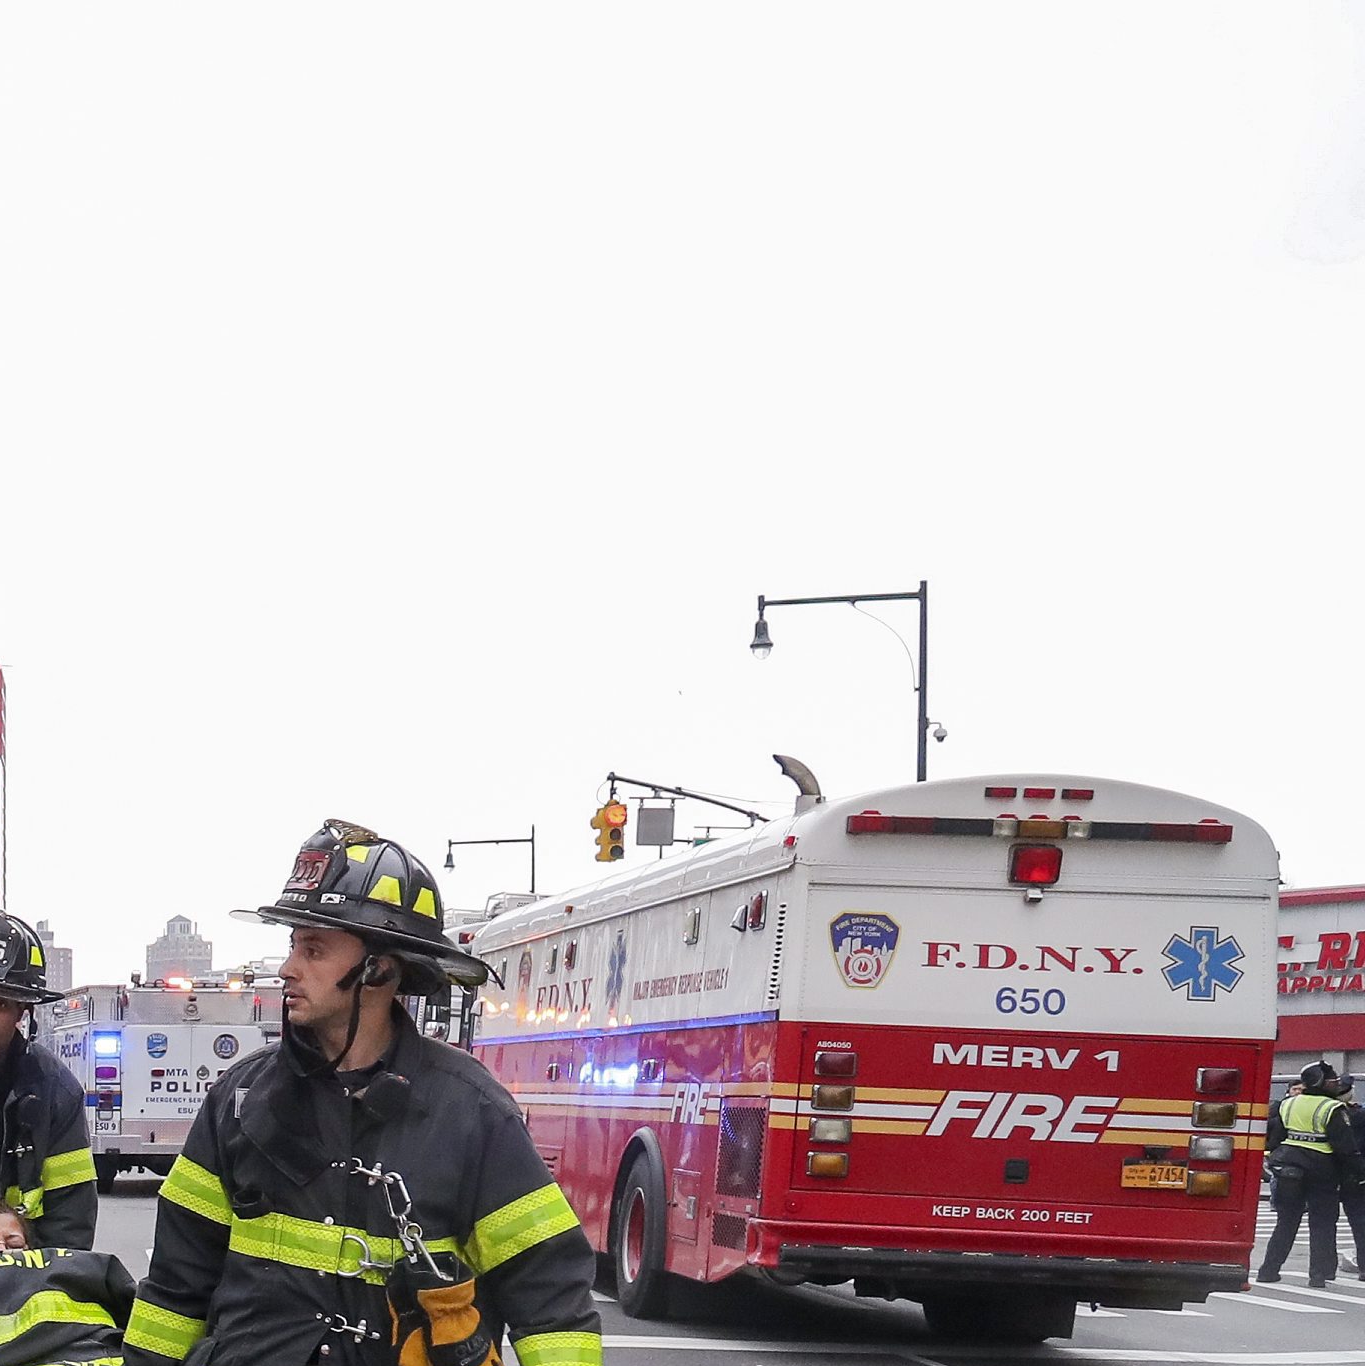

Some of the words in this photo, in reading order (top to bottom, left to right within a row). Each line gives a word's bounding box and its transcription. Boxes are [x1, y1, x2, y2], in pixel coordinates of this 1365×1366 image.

[851, 917, 894, 933] DEPARTMENT
[921, 941, 1144, 974] F.D.N.Y.
[996, 987, 1066, 1015] 650
[932, 1043, 1081, 1071] MERV
[1094, 1050, 1120, 1072] 1
[166, 1068, 189, 1077] MTA
[671, 1083, 712, 1124] FIRE
[111, 1122, 117, 1131] 9
[925, 1090, 1119, 1143] FIRE
[1158, 1167, 1185, 1182] 7454
[932, 1205, 970, 1218] KEEP
[976, 1207, 1015, 1220] BACK
[1021, 1210, 1050, 1222] 200
[1055, 1211, 1093, 1224] FEET
